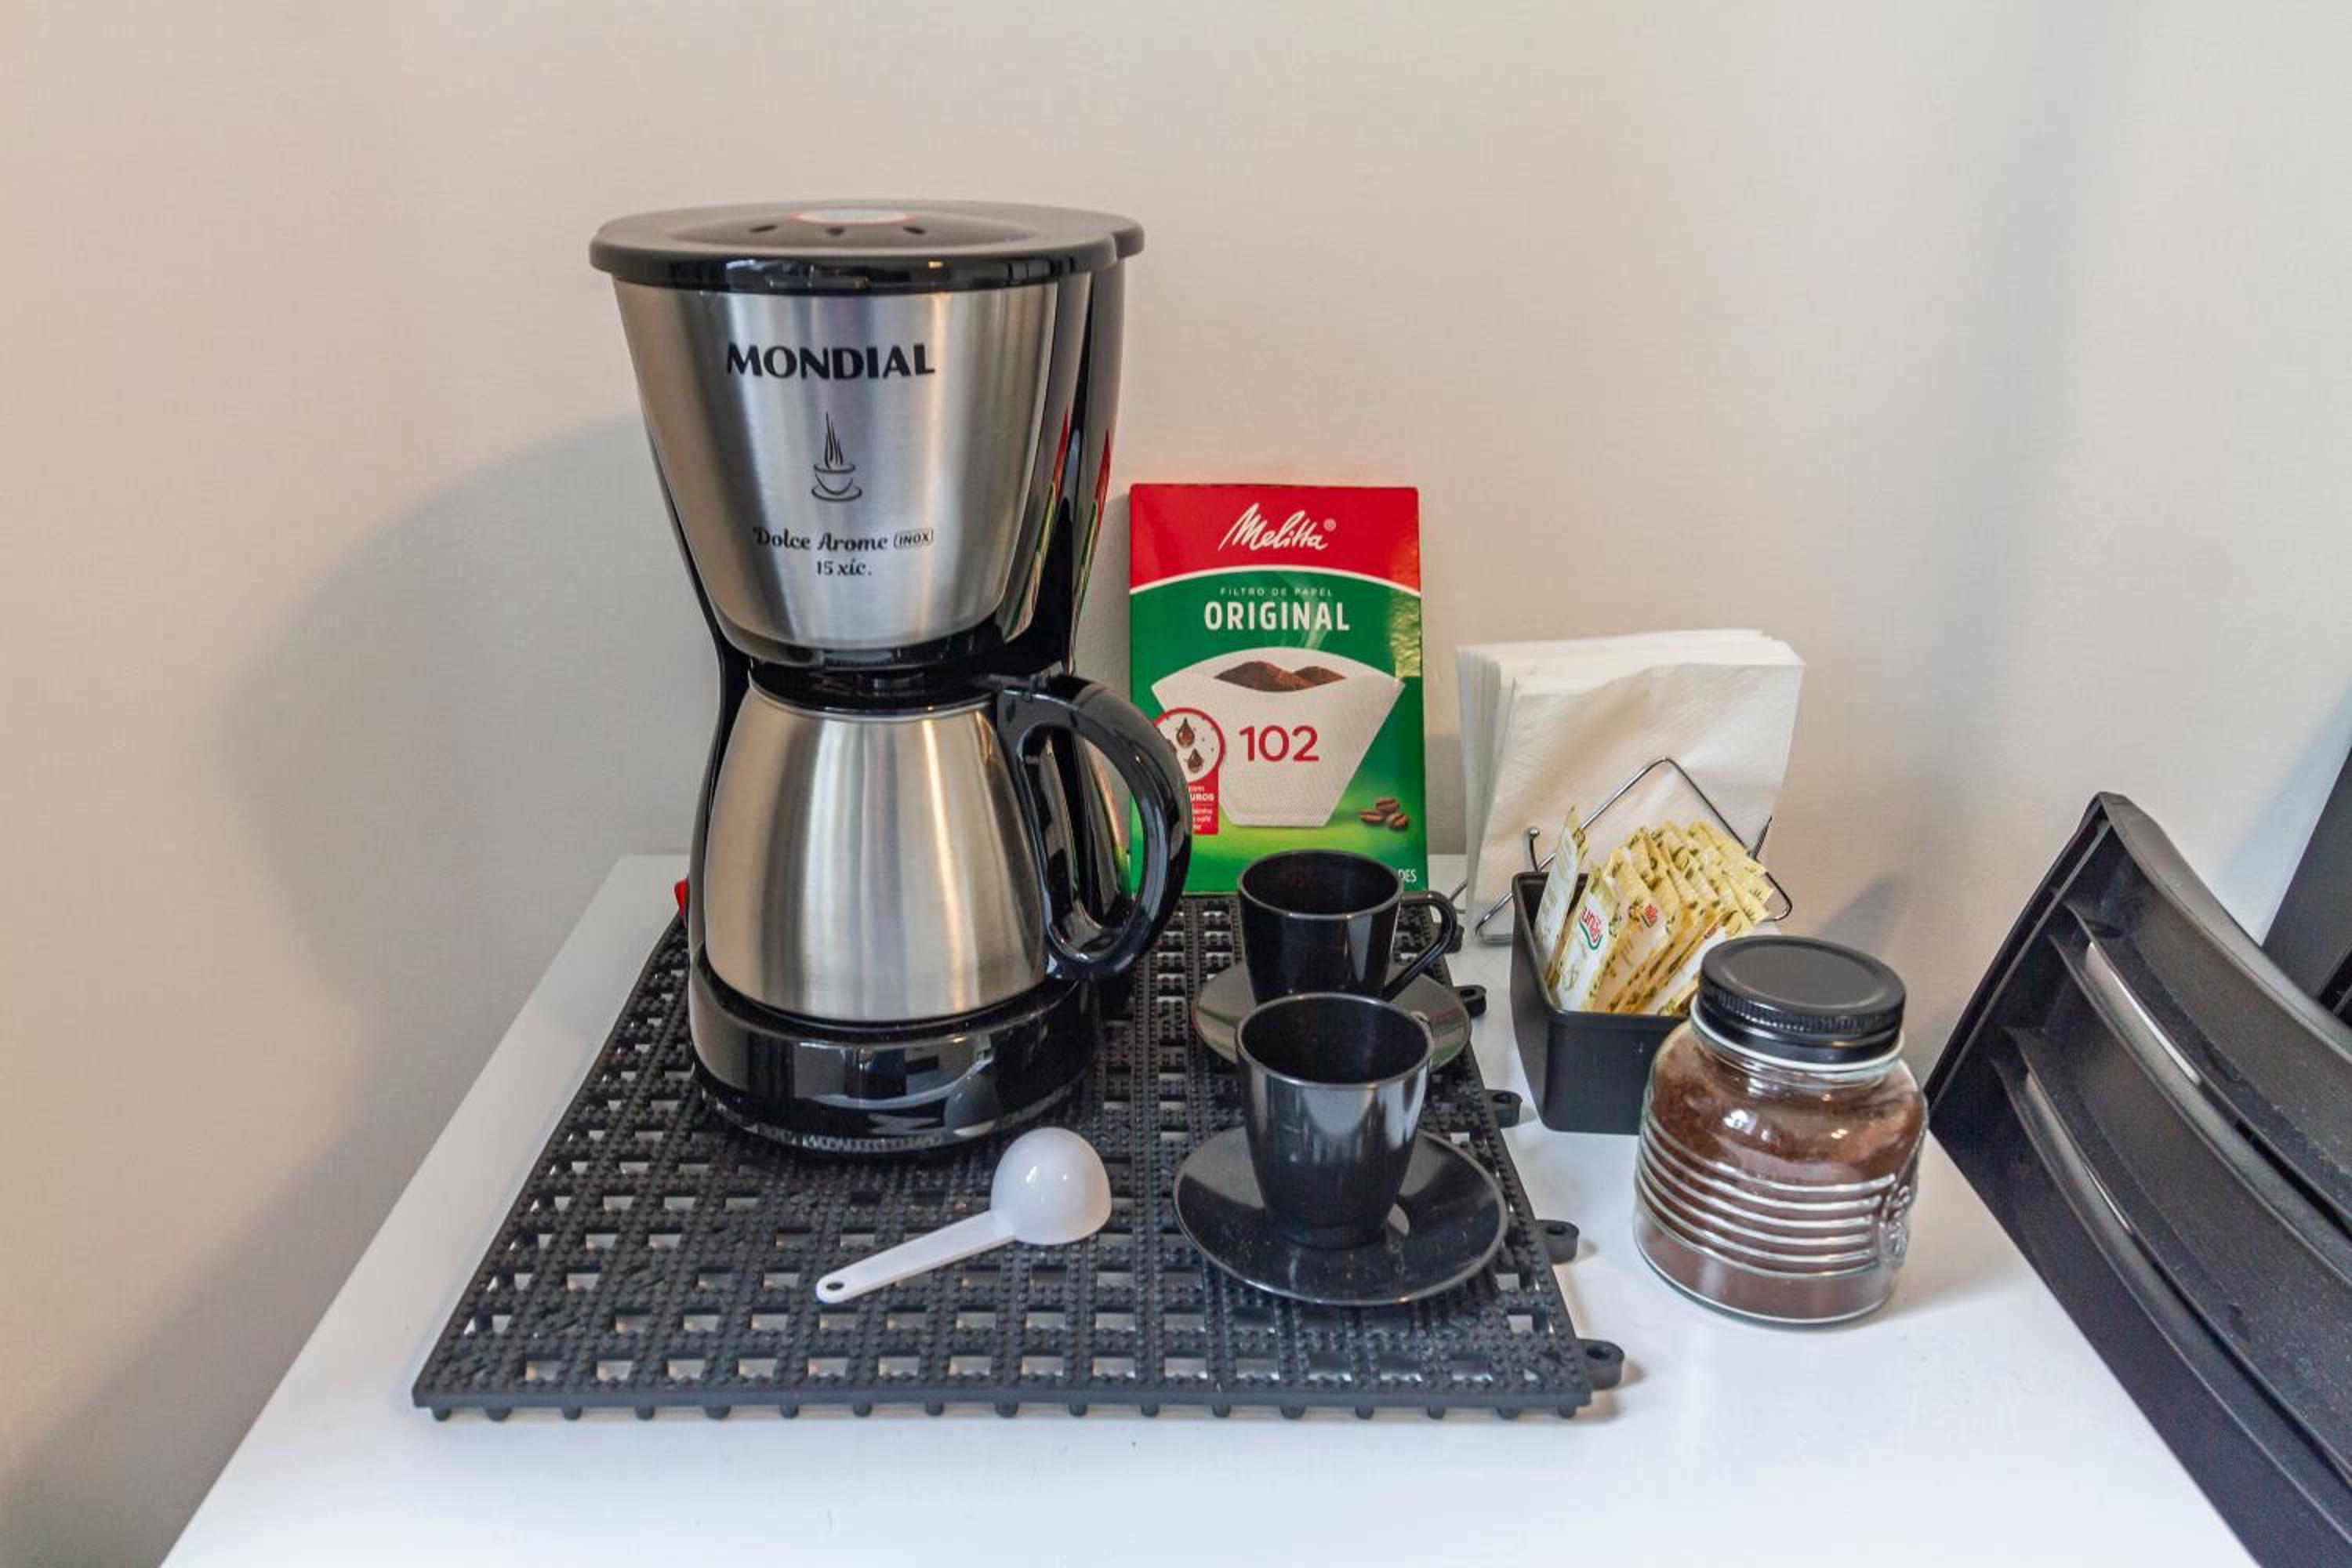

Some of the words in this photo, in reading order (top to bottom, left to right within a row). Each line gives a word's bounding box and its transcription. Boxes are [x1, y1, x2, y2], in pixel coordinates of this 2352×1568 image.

[726, 342, 935, 380] MONDIAL
[752, 526, 811, 550] Dolce
[817, 532, 888, 552] Arome
[897, 531, 931, 547] INOX
[1217, 502, 1329, 551] Melitta
[816, 560, 833, 575] 15
[1220, 586, 1265, 597] FILTRO
[1270, 586, 1287, 597] DE
[1294, 586, 1333, 597] PAPEL
[1204, 601, 1351, 631] ORIGINAL
[1239, 725, 1319, 762] 102
